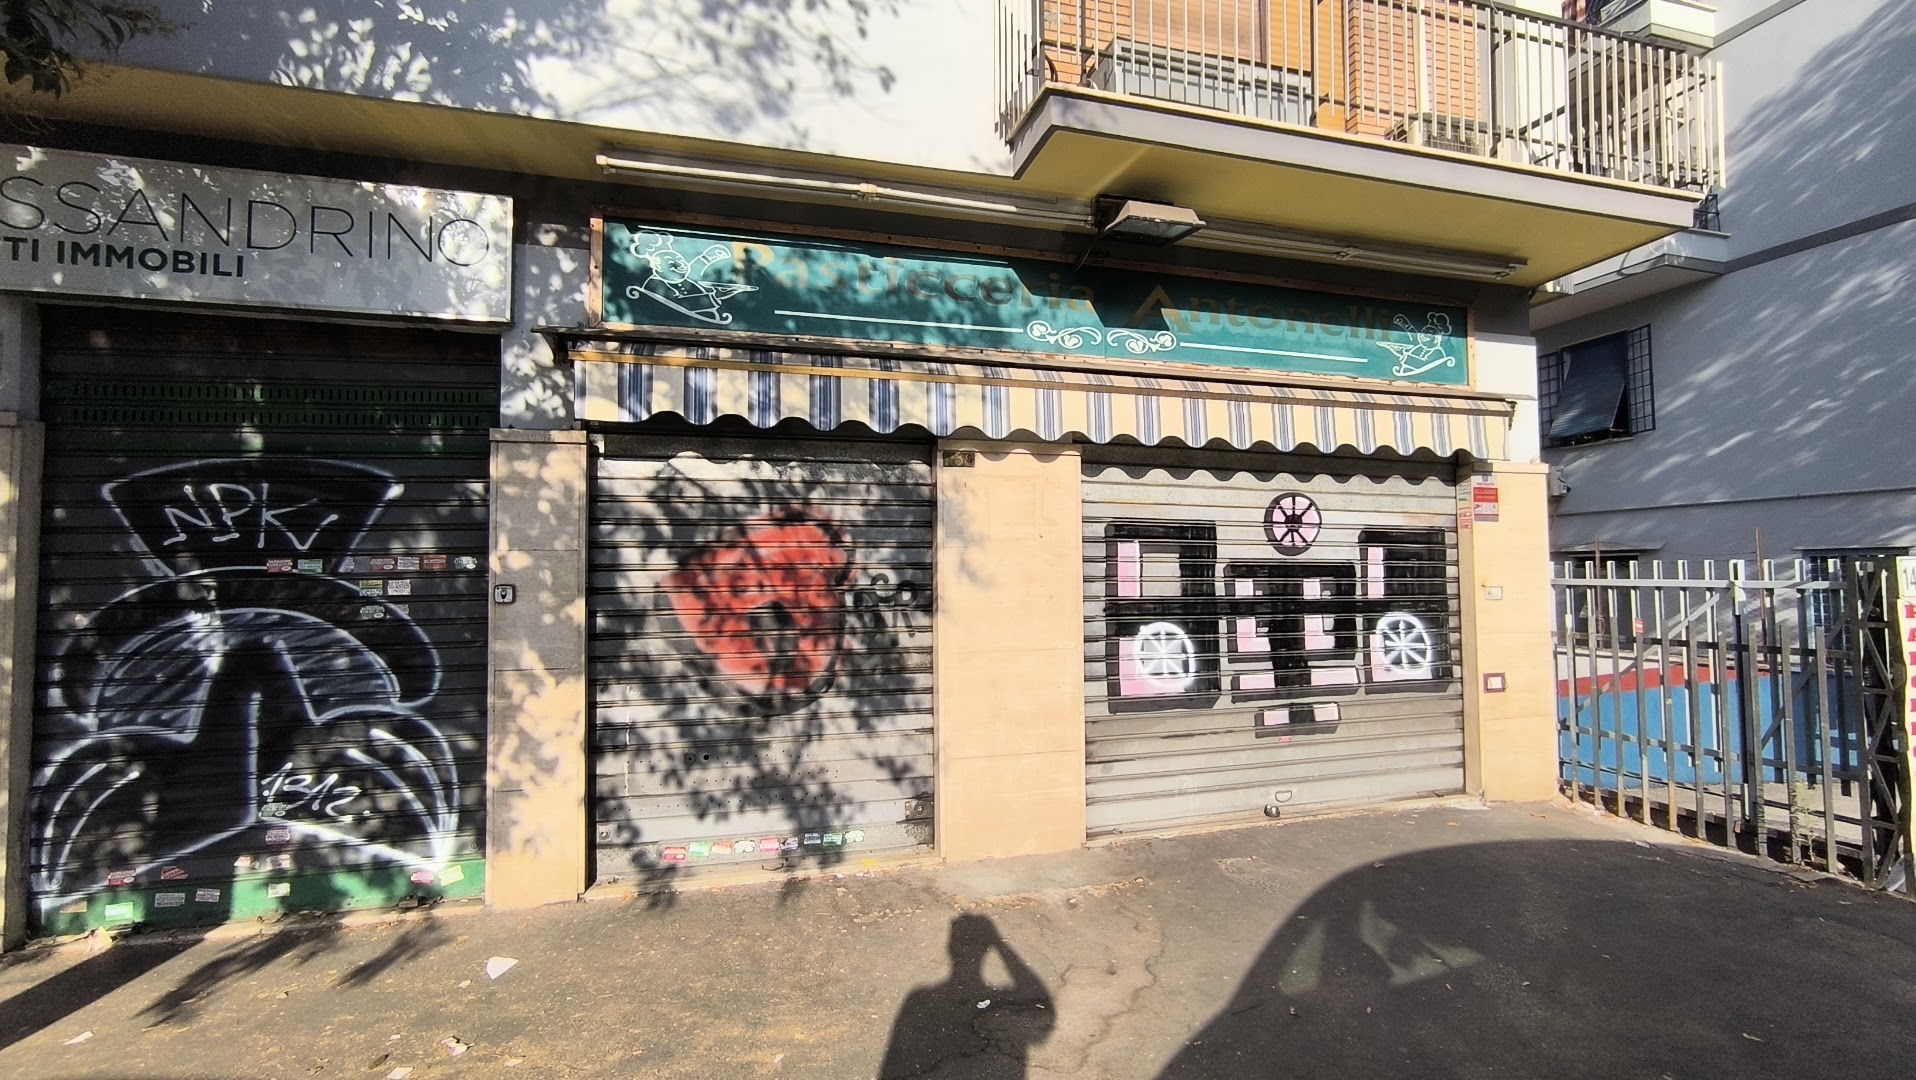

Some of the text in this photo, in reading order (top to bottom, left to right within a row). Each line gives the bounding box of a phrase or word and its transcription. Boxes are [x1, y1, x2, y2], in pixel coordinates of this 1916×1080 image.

[0, 176, 490, 267] SSANDRINO
[57, 237, 244, 278] IMMOBILI
[732, 241, 1392, 342] Pasticceria Antonelli
